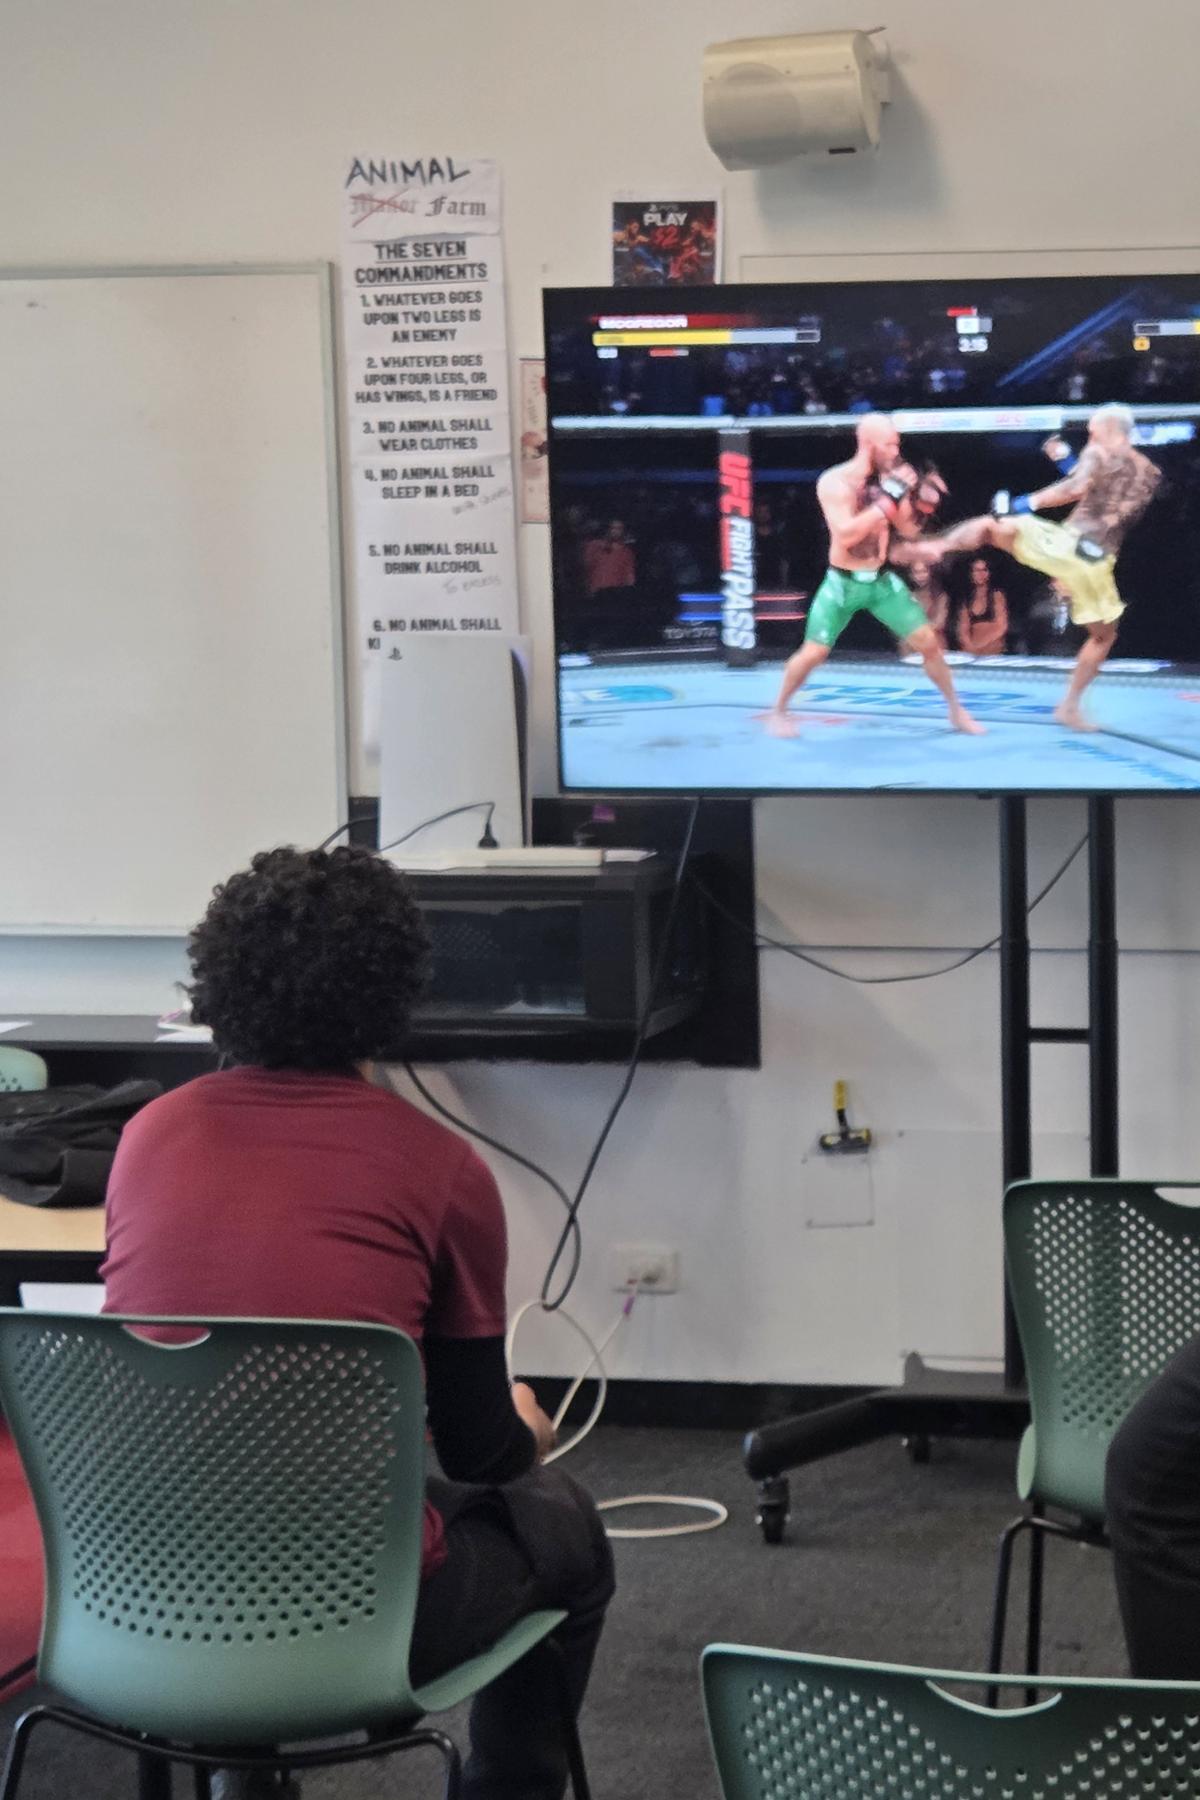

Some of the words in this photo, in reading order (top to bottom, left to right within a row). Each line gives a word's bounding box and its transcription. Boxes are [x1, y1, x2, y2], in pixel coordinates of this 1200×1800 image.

[345, 157, 471, 188] ANIMAL
[425, 196, 487, 217] Farm
[643, 212, 688, 226] PLAY
[374, 242, 409, 260] THE
[412, 240, 467, 258] SEVEN
[354, 262, 488, 284] COMMANDMENTS
[374, 291, 446, 306] WHATEVER
[448, 290, 483, 304] GOES
[363, 312, 400, 326] UPON
[402, 310, 431, 324] TWO
[434, 309, 466, 323] LEGS
[469, 308, 482, 322] IS
[391, 330, 410, 343] AN
[412, 328, 457, 342] ENEMY
[366, 357, 378, 369] 2.
[381, 355, 449, 368] WHATEVER
[451, 354, 483, 367] GOES
[364, 373, 397, 386] UPON
[400, 372, 432, 385] FOUR
[435, 371, 469, 385] LEGS,
[471, 371, 488, 384] OR
[355, 391, 382, 403] HAS
[384, 390, 427, 403] WINGS,
[429, 389, 441, 402] IS
[454, 388, 498, 401] FRIEND
[363, 421, 375, 434] 3.
[378, 420, 395, 433] NO
[398, 419, 447, 433] ANIMAL
[449, 418, 493, 431] SHALL
[379, 438, 418, 452] WEAR
[420, 437, 478, 450] CLOTHES
[364, 469, 377, 482] 4.
[380, 468, 398, 481] NO
[401, 467, 449, 480] ANIMAL
[451, 465, 495, 479] SHALL
[381, 486, 421, 499] SLEEP
[425, 485, 438, 498] IN
[441, 485, 451, 497] A
[454, 484, 479, 497] BED
[719, 451, 752, 518] UFC
[368, 545, 381, 557] 5.
[384, 544, 400, 557] NO
[404, 542, 451, 556] ANIMAL
[454, 542, 498, 555] SHALL
[729, 515, 754, 578] FIGHT
[384, 562, 421, 575] DRINK
[425, 560, 483, 574] ALCOHOL
[720, 572, 756, 650] PASS
[373, 620, 386, 632] 6.
[389, 619, 406, 632] NO
[410, 618, 457, 631] ANIMAL
[460, 617, 502, 630] SHALL
[367, 637, 381, 650] KI
